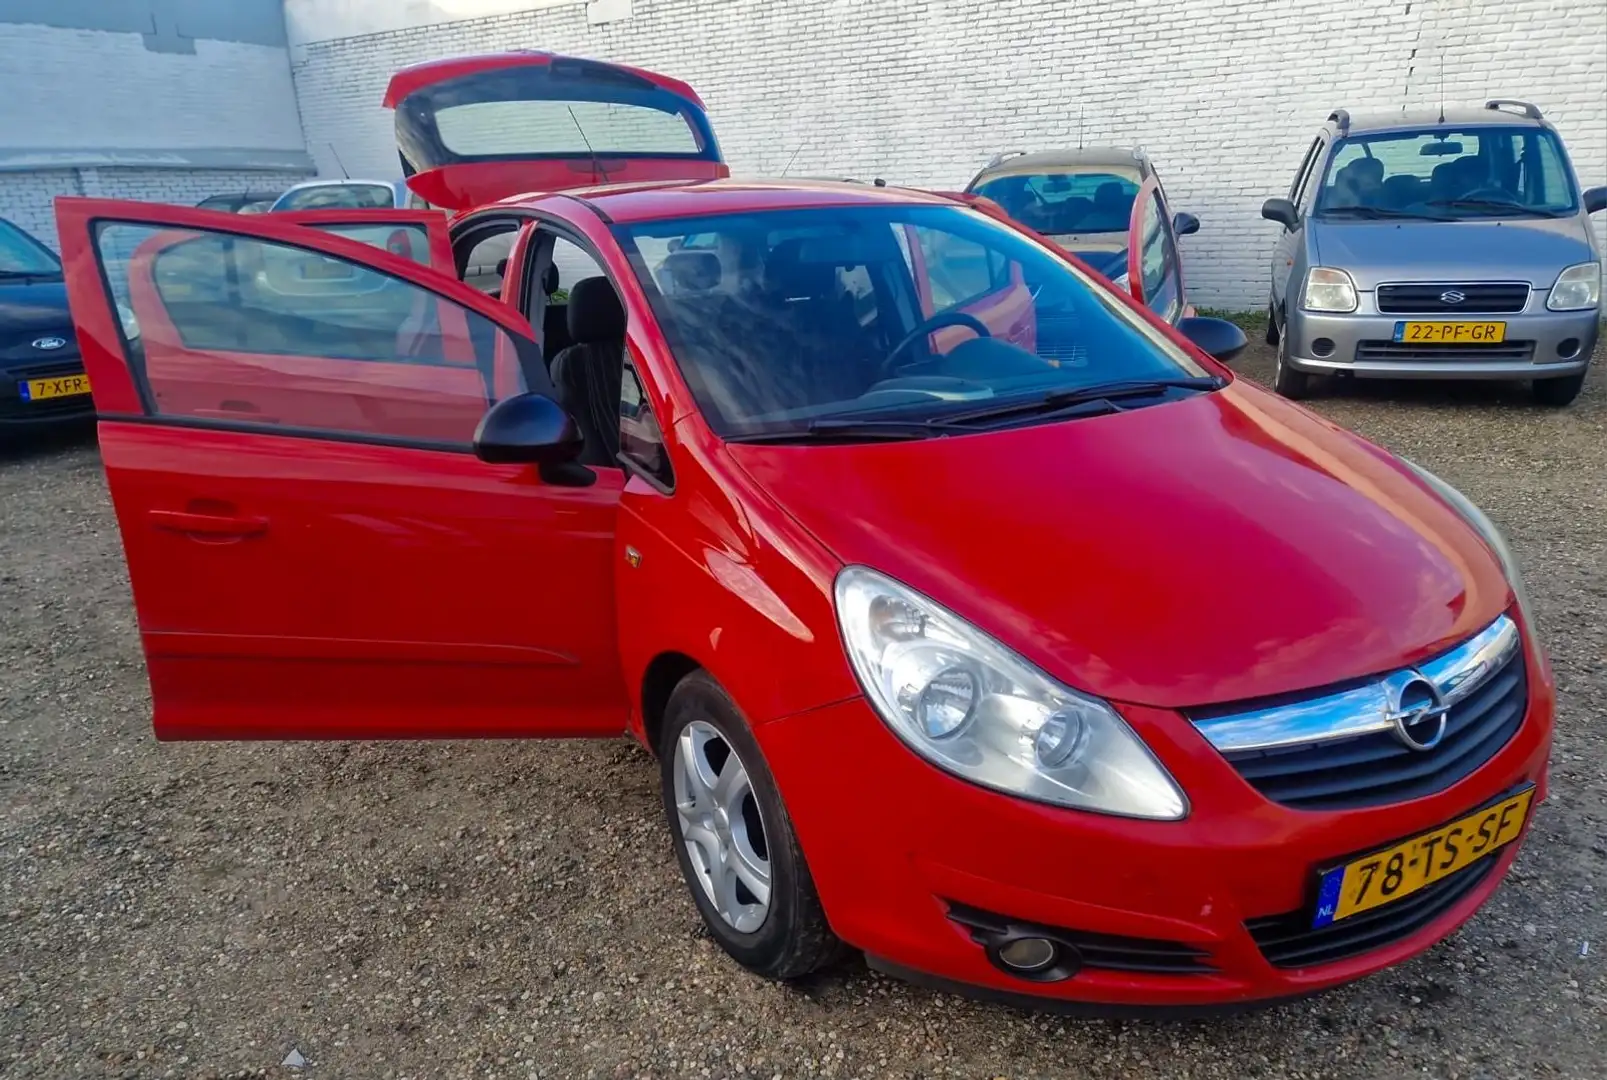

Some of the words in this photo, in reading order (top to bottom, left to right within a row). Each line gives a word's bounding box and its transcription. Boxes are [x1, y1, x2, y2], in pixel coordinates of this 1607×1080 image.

[1411, 325, 1496, 339] 22-PF-GR
[1355, 803, 1518, 905] 78-TS-SF
[1317, 903, 1333, 919] NL
